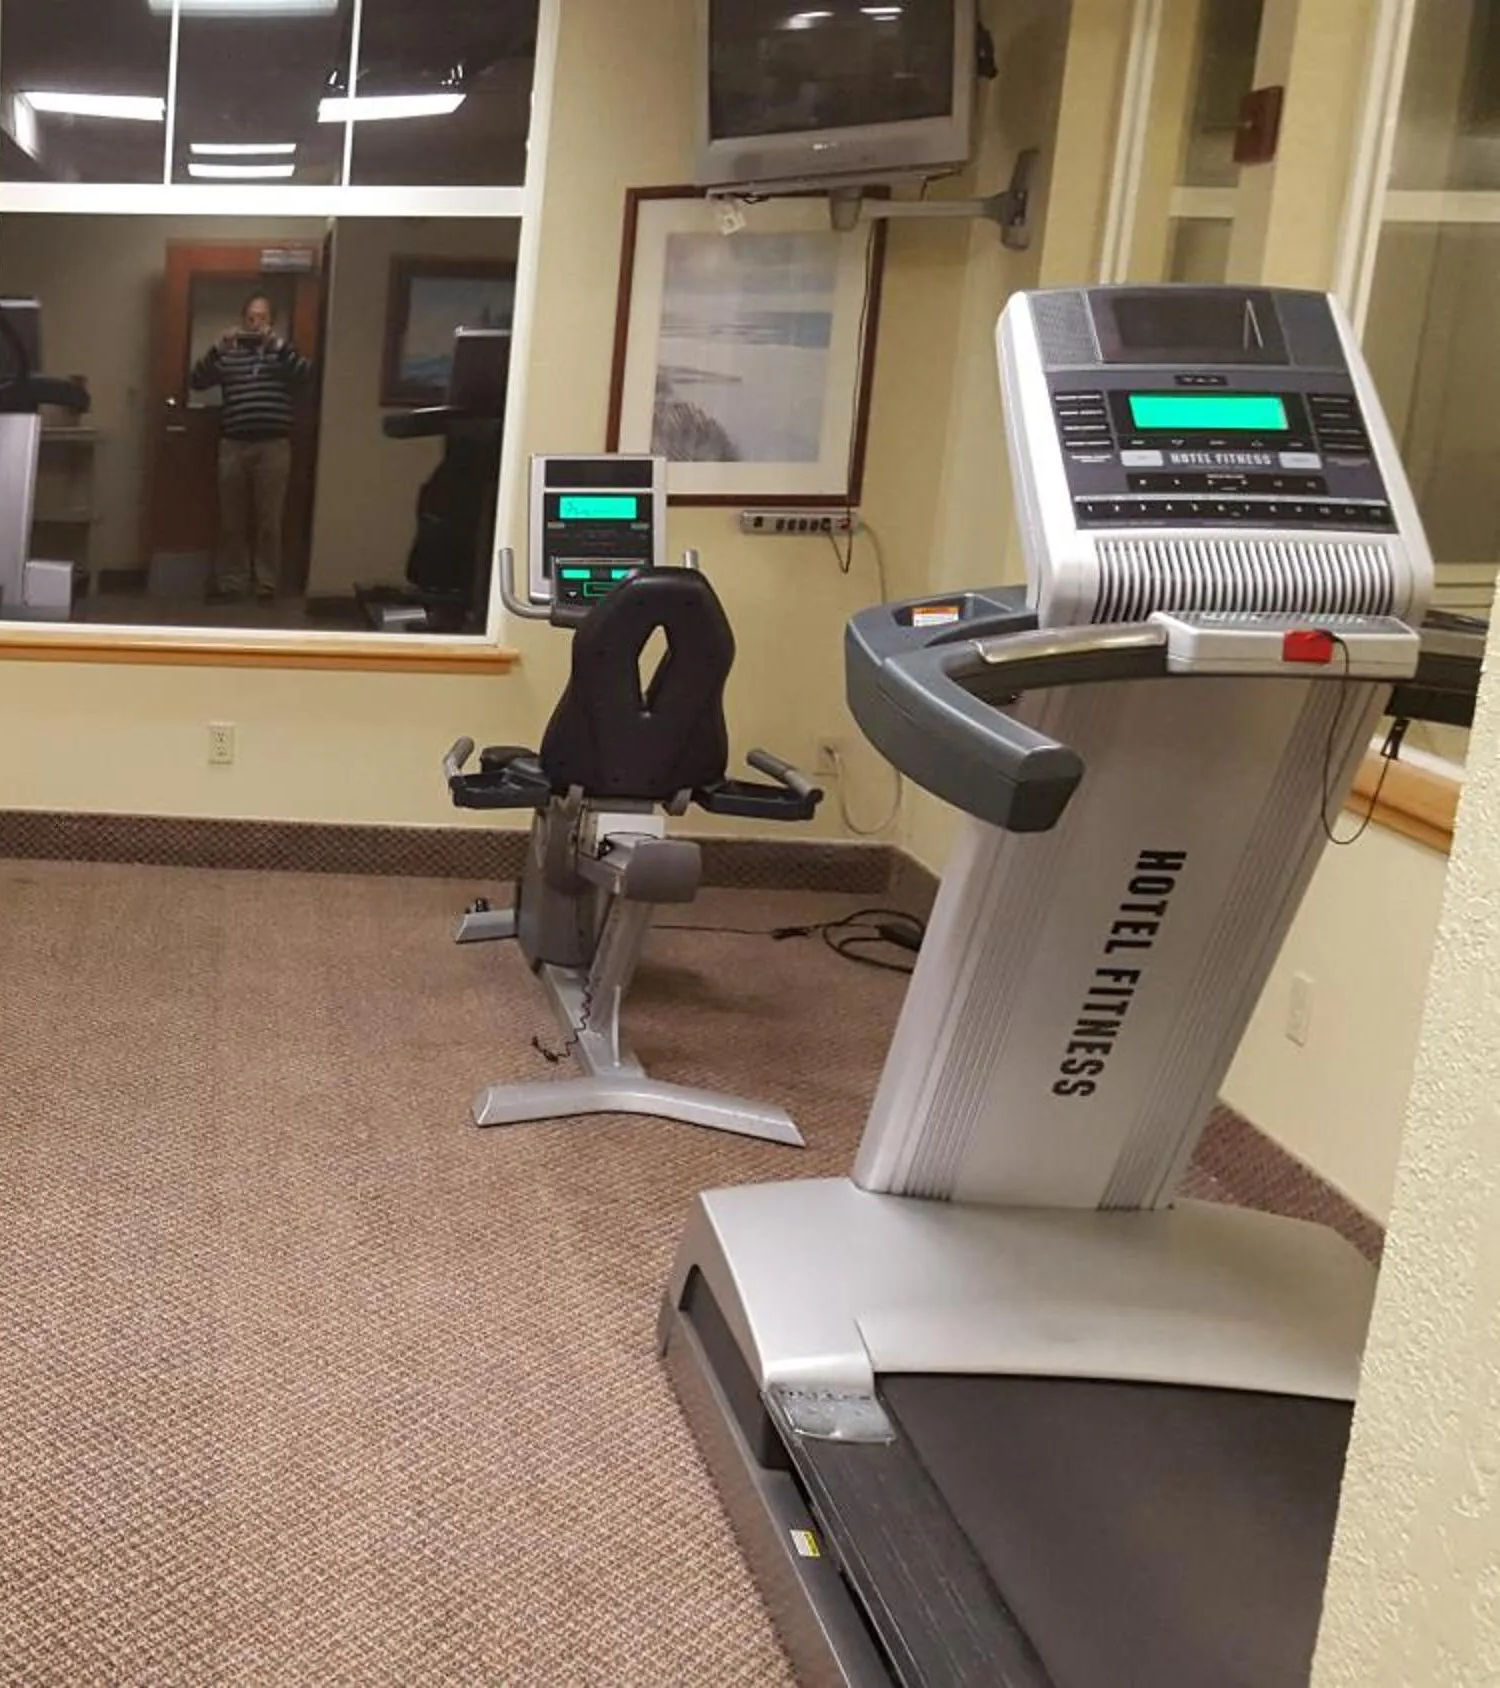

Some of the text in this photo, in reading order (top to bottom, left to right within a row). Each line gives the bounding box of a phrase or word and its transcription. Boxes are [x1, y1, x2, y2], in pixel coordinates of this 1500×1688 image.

[1170, 452, 1272, 465] HOTEL FITNESS
[1052, 850, 1187, 1097] HOTEL FITNESS
